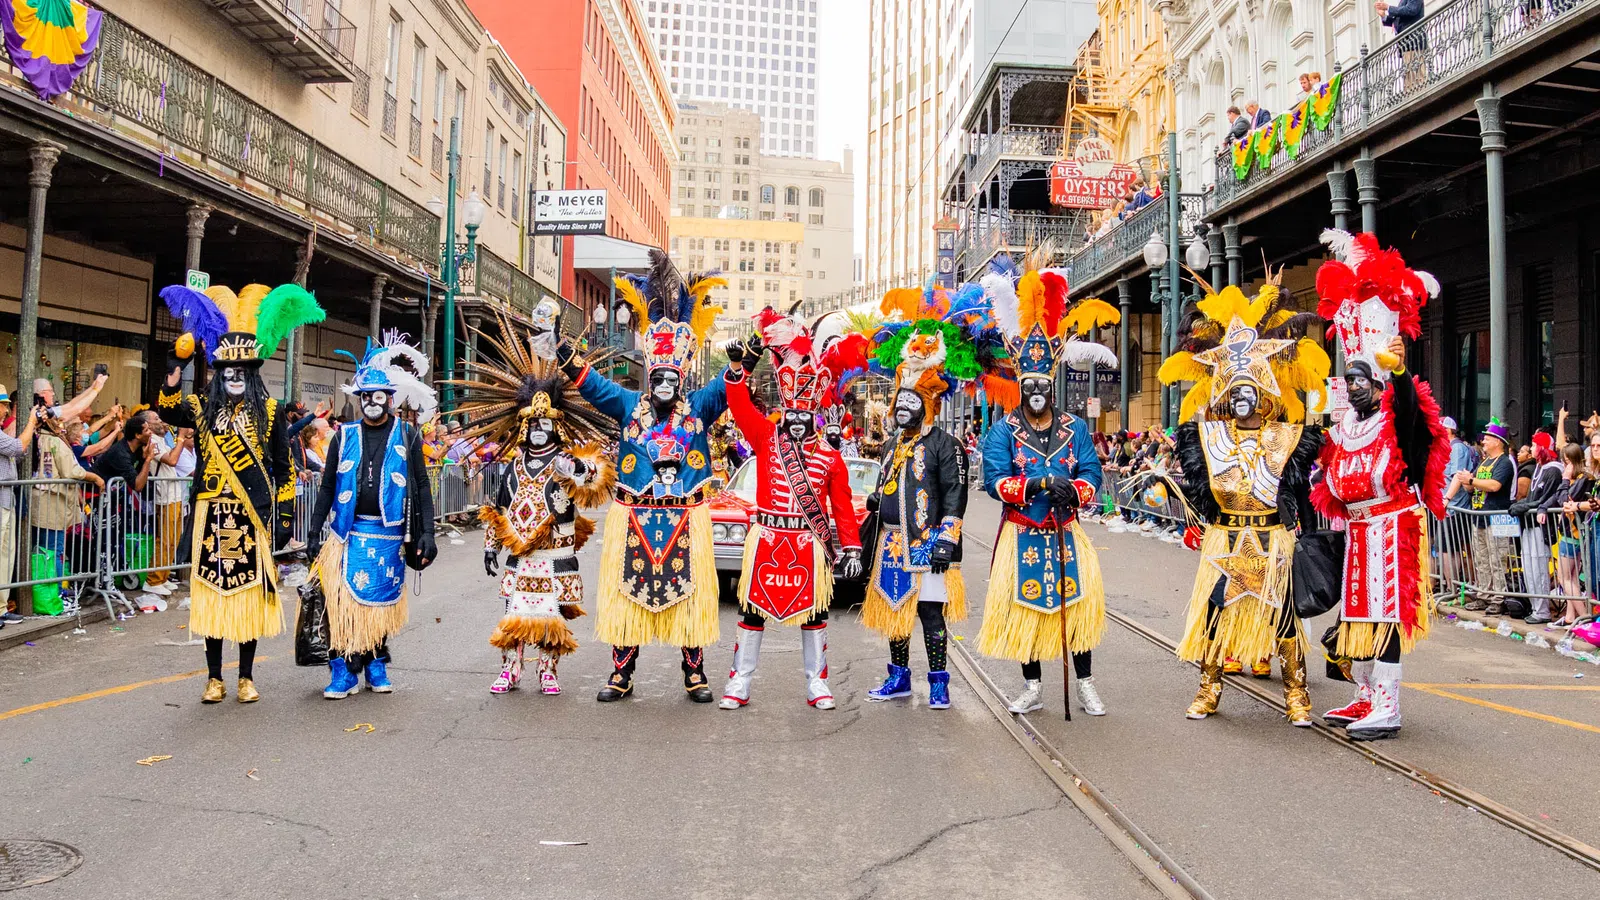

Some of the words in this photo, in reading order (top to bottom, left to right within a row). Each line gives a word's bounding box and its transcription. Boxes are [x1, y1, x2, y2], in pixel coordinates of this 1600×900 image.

[1077, 150, 1114, 166] PEARL
[1057, 166, 1133, 180] RESANT
[1064, 179, 1126, 198] OYSTERS
[558, 195, 604, 206] MEYER
[559, 207, 573, 216] The
[537, 223, 557, 231] Quality
[571, 222, 588, 230] Since
[588, 222, 603, 230] 1894
[214, 434, 254, 472] ZULU
[779, 432, 819, 514] SATURDAY
[954, 445, 966, 485] ZULU
[760, 512, 808, 529] TRAMP
[1228, 515, 1267, 527] ZULU
[1029, 527, 1058, 536] ZUL
[215, 528, 243, 559] Z
[652, 513, 664, 608] TRAMPS
[882, 561, 903, 569] TRAM
[1351, 528, 1361, 607] TRAMPS
[201, 565, 255, 588] TRAMPS
[1043, 535, 1055, 607] TRAMPS
[765, 573, 802, 587] ZULU
